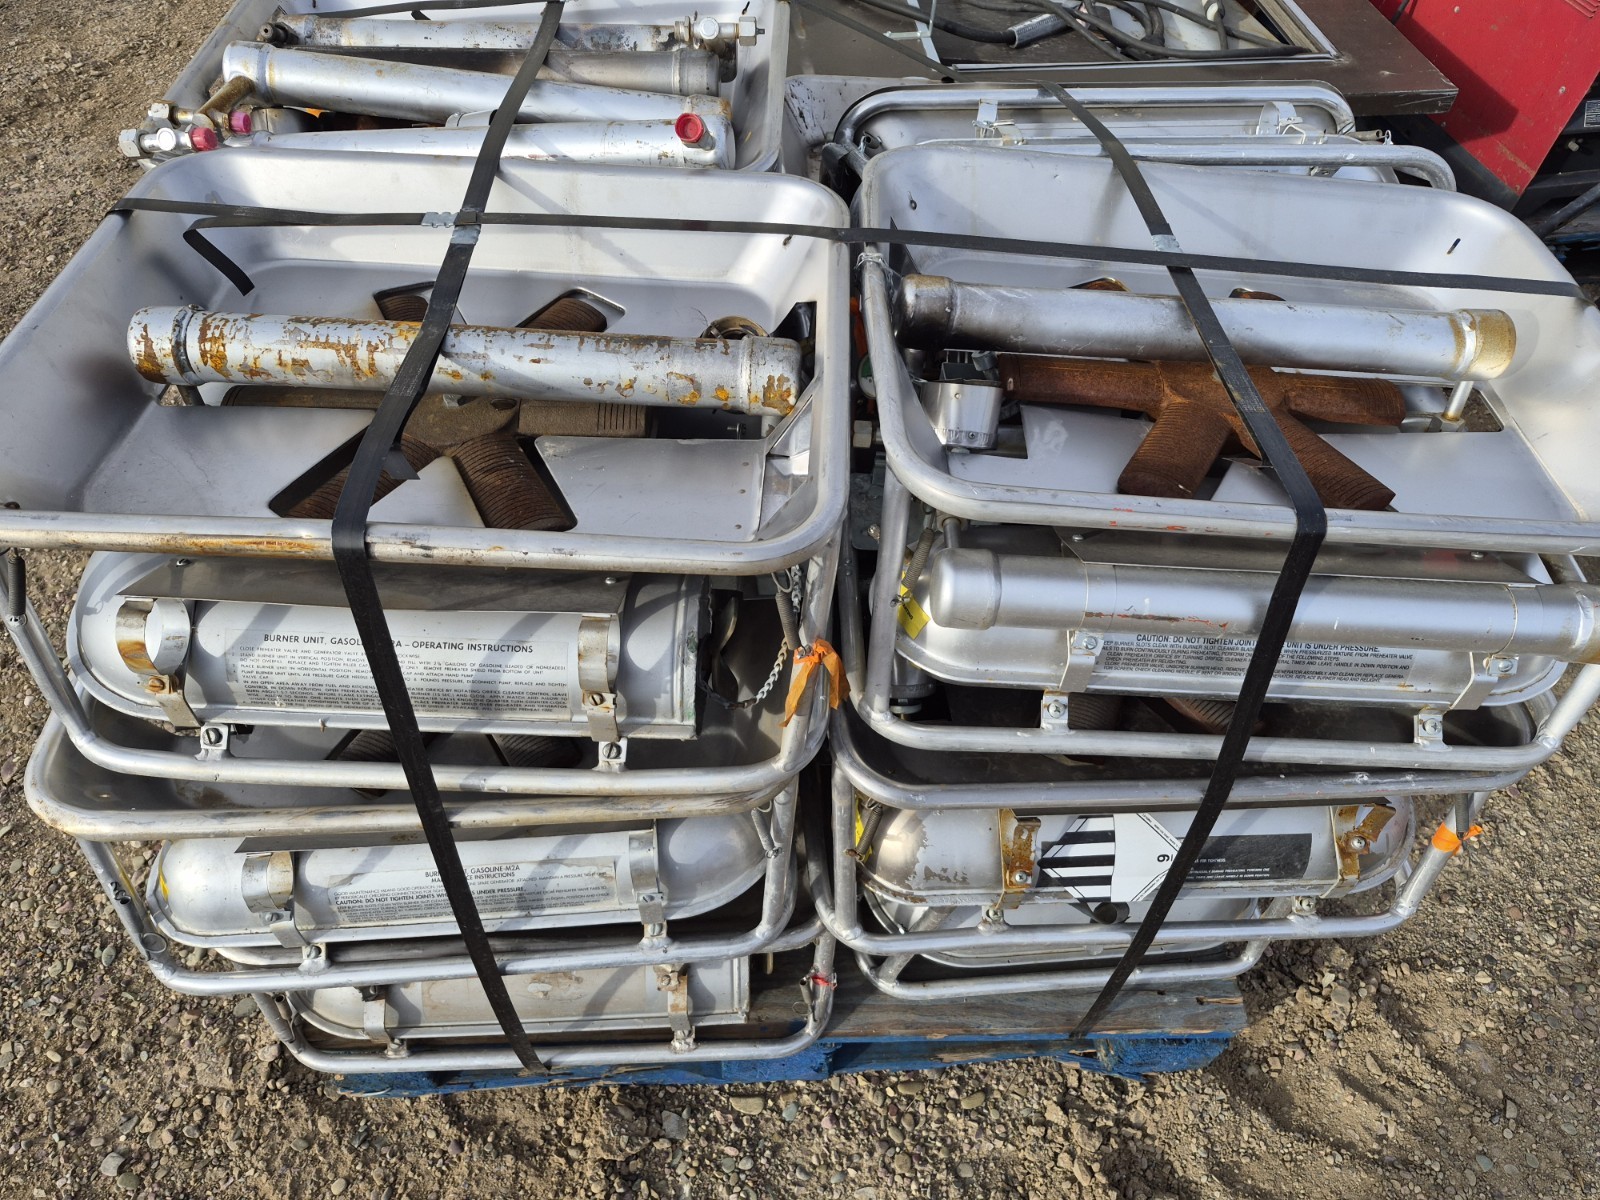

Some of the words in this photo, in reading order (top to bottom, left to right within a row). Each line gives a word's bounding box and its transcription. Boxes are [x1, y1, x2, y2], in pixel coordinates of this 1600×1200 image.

[264, 634, 299, 643] BURNER
[304, 636, 326, 645] UNIT,
[412, 641, 464, 650] OPERATING
[468, 644, 533, 653] INSTRUCTIONS
[1137, 634, 1171, 642] CAUTION:
